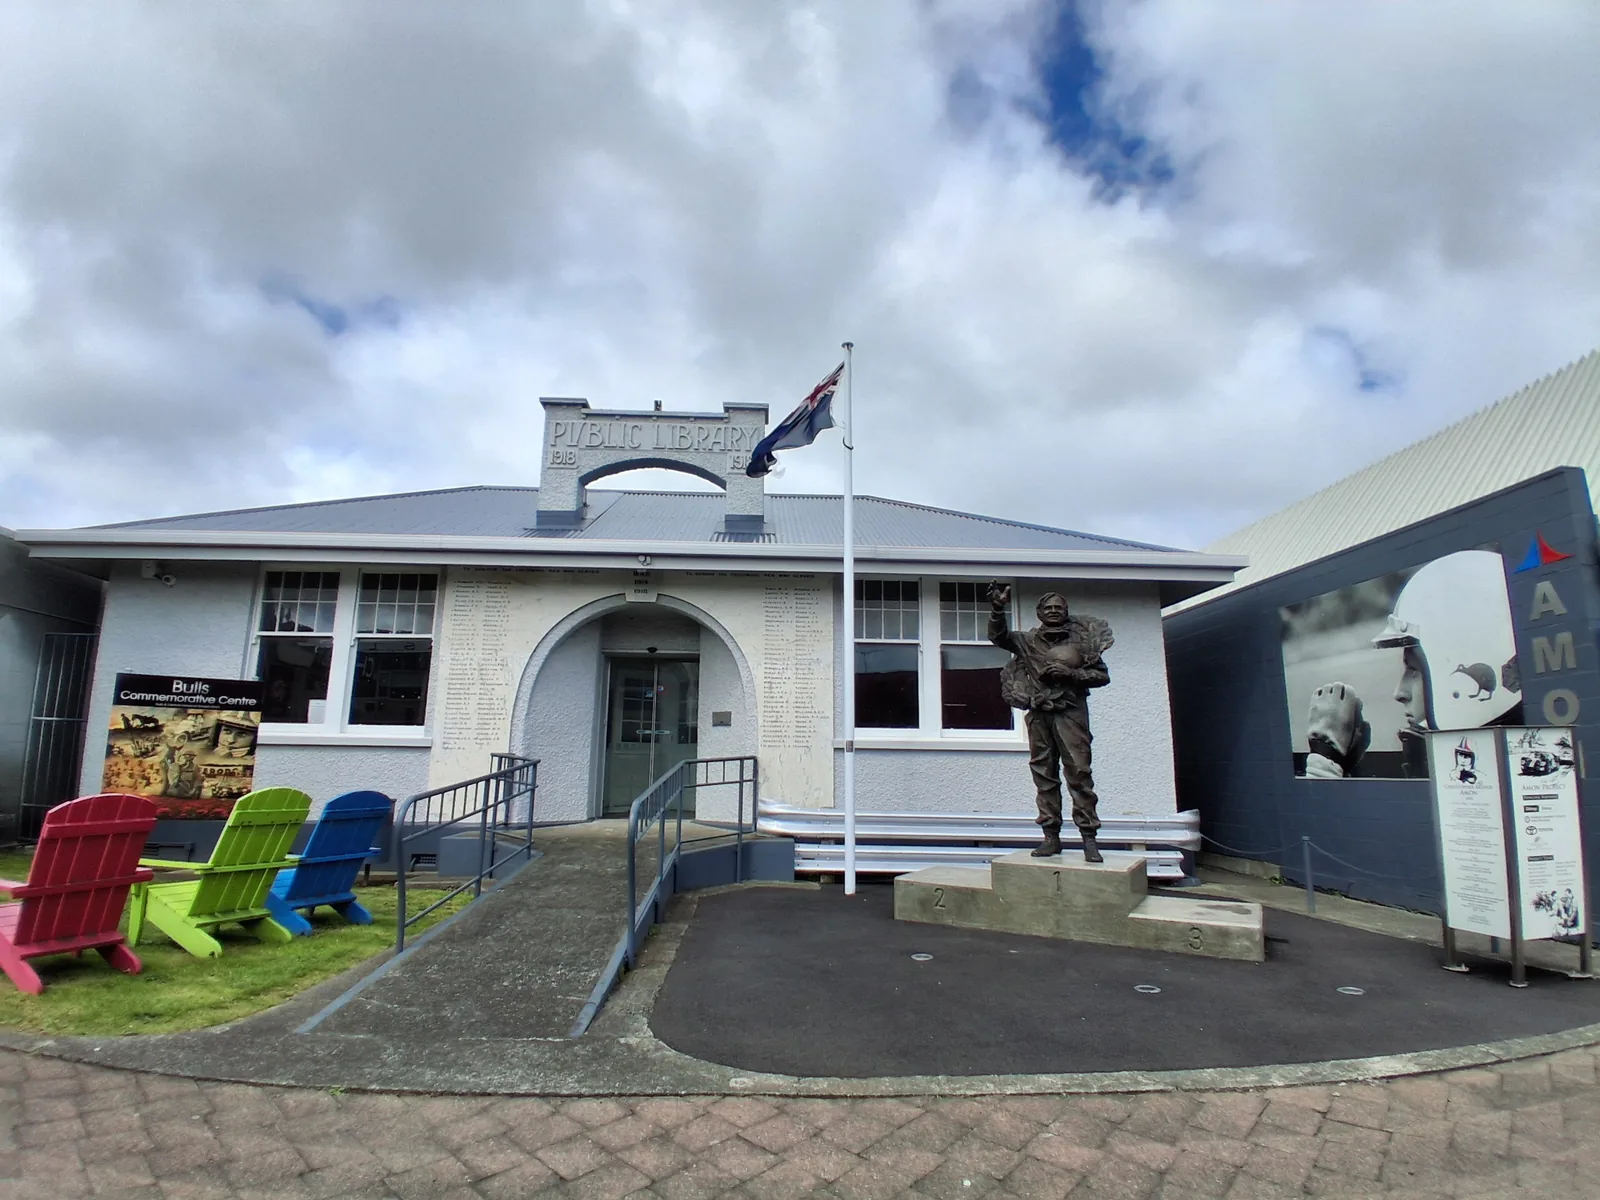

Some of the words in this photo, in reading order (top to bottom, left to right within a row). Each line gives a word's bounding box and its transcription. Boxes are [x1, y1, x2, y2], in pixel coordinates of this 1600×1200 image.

[651, 424, 758, 451] LIBRARY
[549, 450, 577, 465] 1918
[172, 680, 210, 694] Bulls
[120, 690, 216, 705] Commemorative
[218, 696, 257, 706] Centre
[1053, 870, 1060, 892] 1
[934, 887, 946, 908] 2
[1188, 926, 1204, 950] 3
